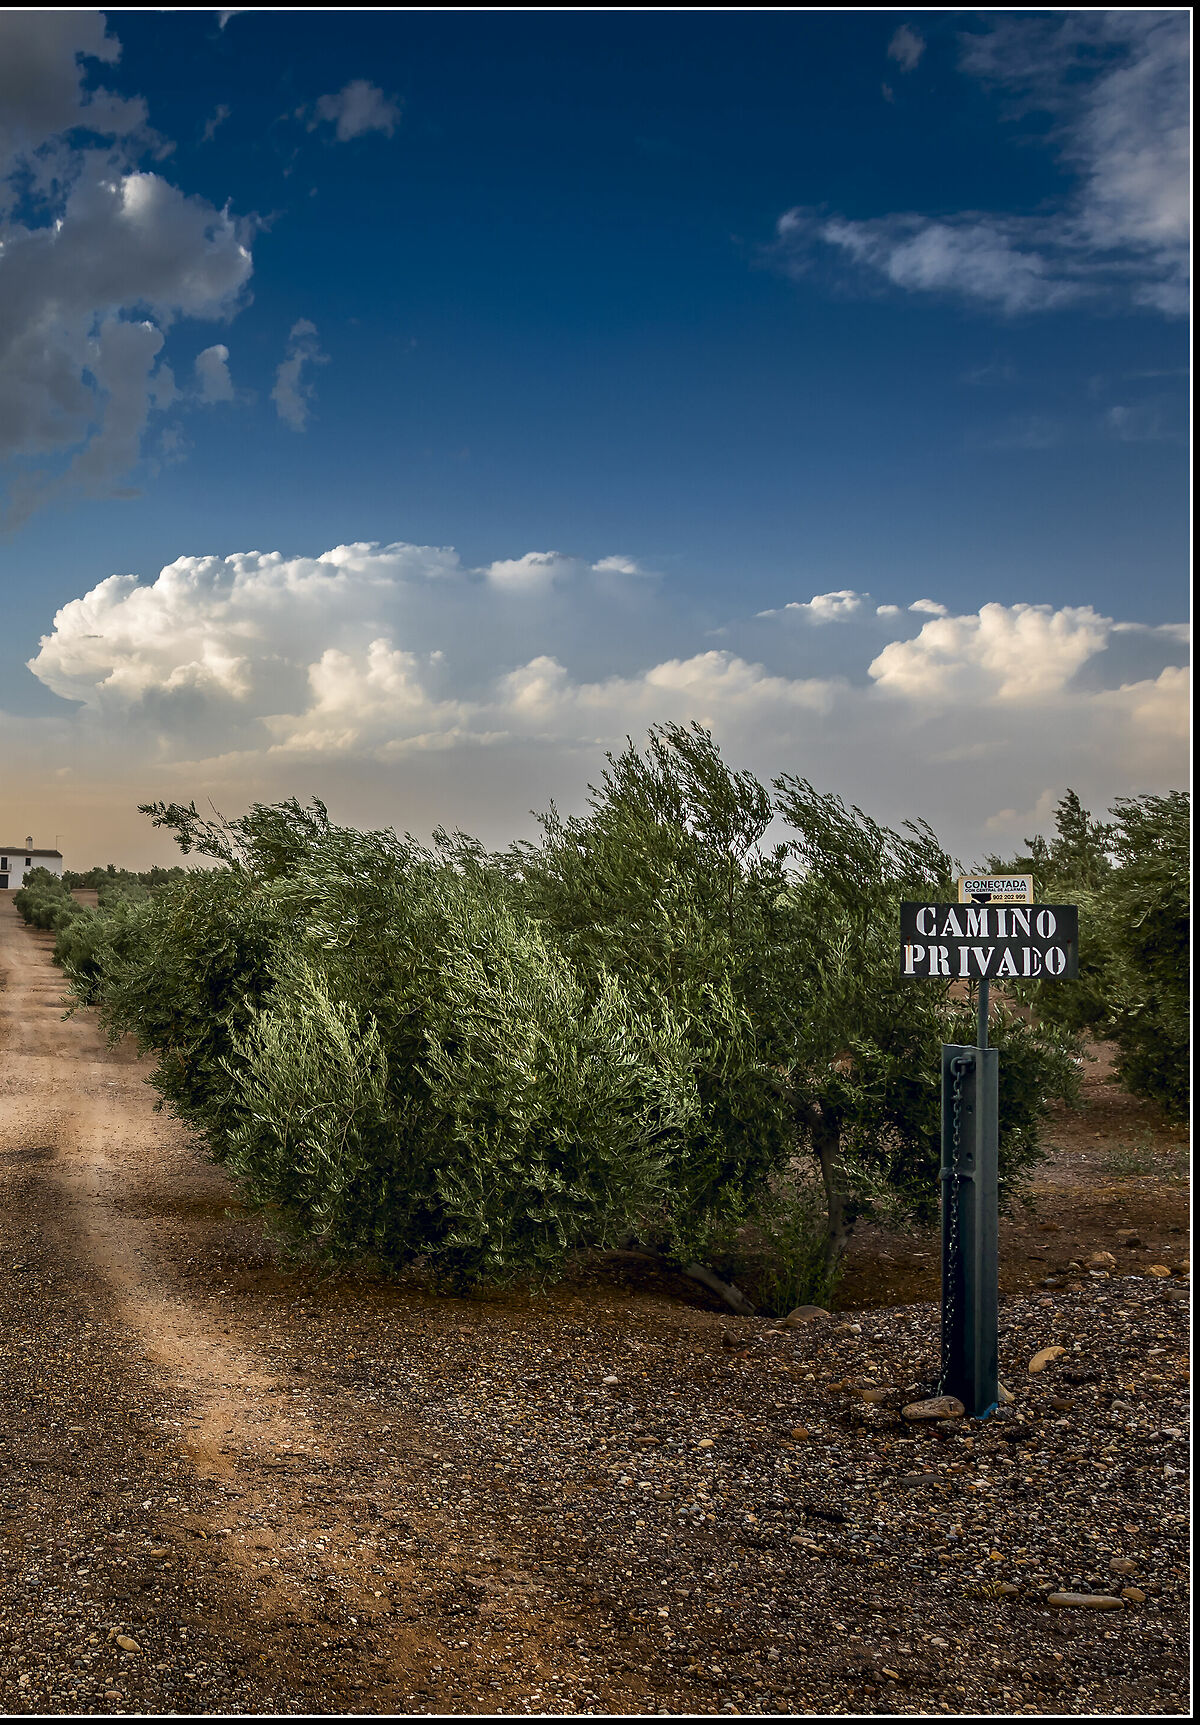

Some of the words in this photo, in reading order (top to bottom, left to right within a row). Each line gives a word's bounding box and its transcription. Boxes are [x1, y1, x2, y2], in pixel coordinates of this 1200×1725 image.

[965, 880, 1027, 888] CONECTADA
[916, 907, 1057, 939] CAMINO
[903, 944, 1067, 977] PRIVADO
